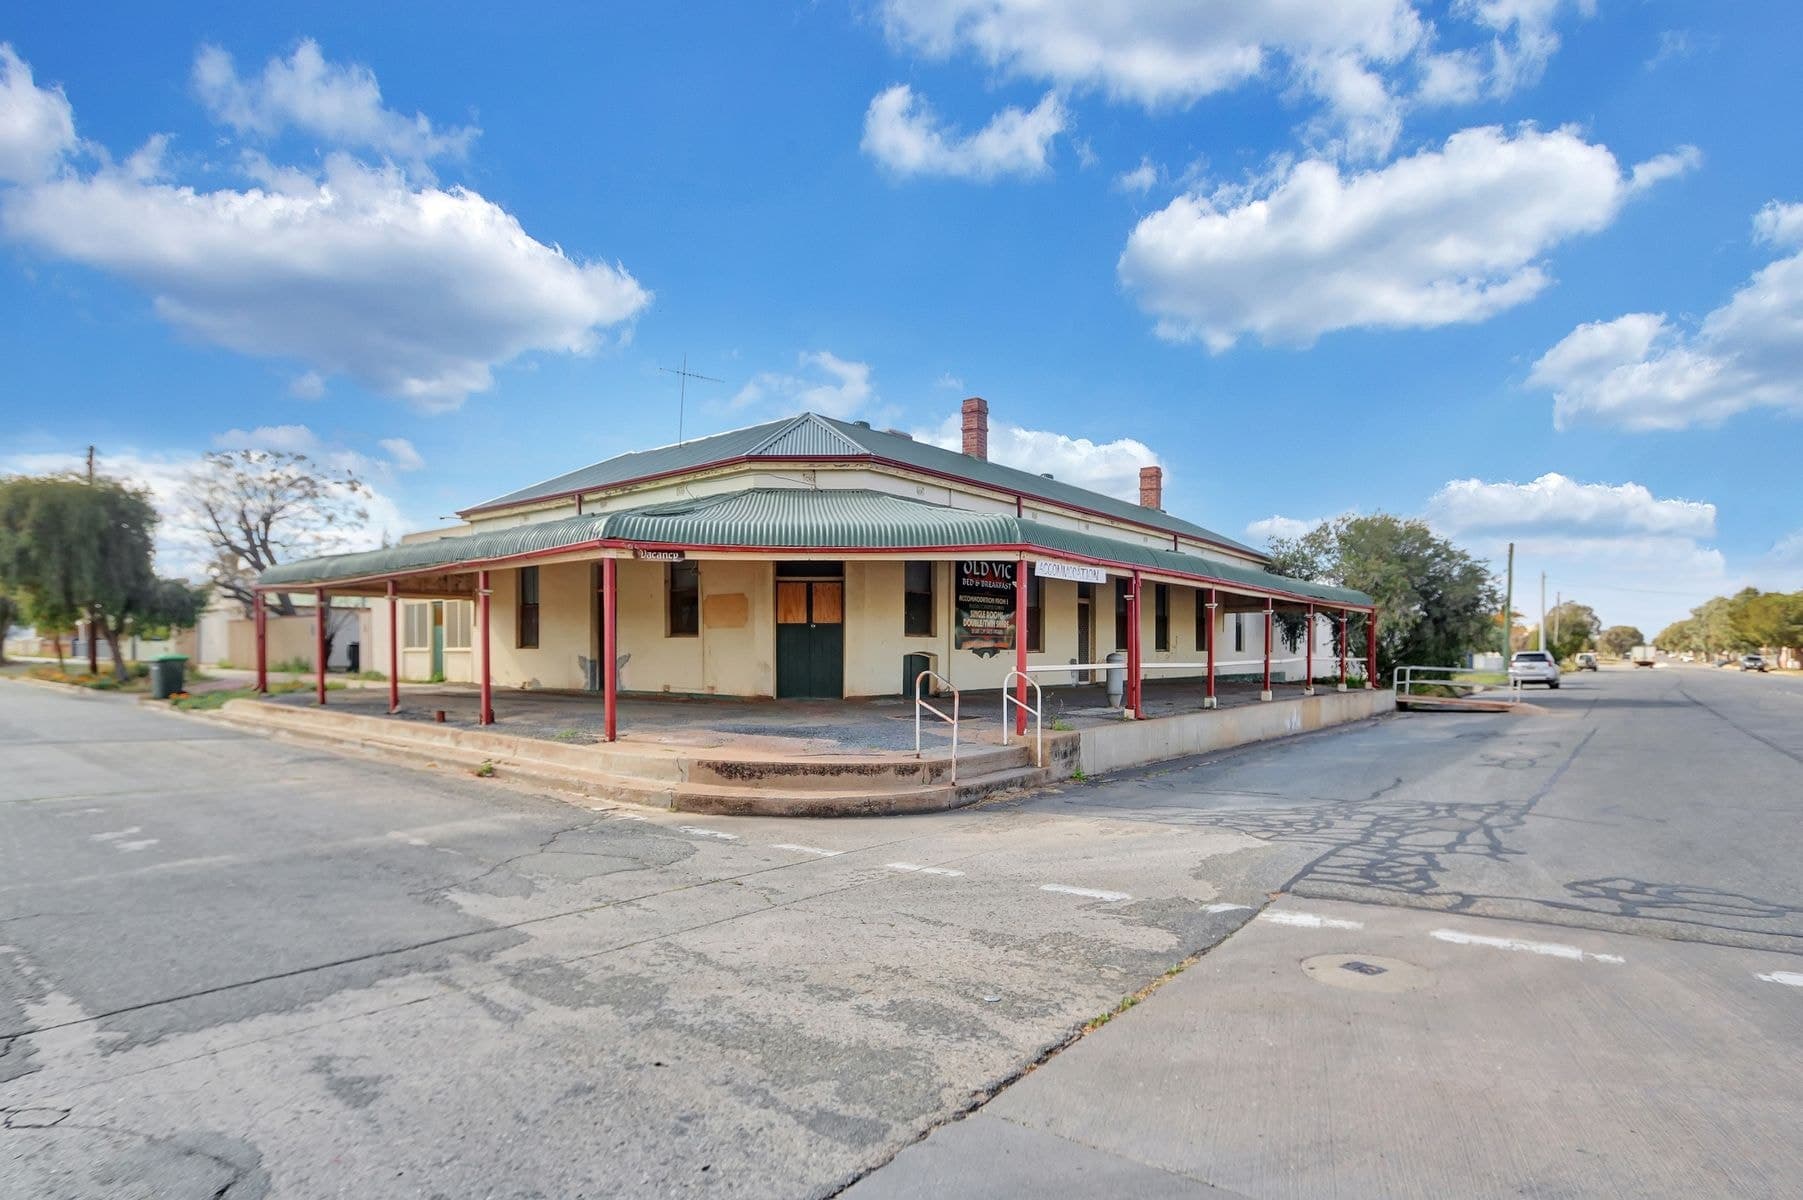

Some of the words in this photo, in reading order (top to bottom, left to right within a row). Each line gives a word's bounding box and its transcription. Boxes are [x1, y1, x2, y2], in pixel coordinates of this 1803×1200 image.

[640, 549, 681, 561] Vacancy
[963, 560, 990, 576] OLD
[992, 562, 1012, 579] VIC
[962, 578, 974, 587] BED
[981, 580, 1012, 590] BREAKFAST
[959, 595, 995, 603] ACCOMMODATION
